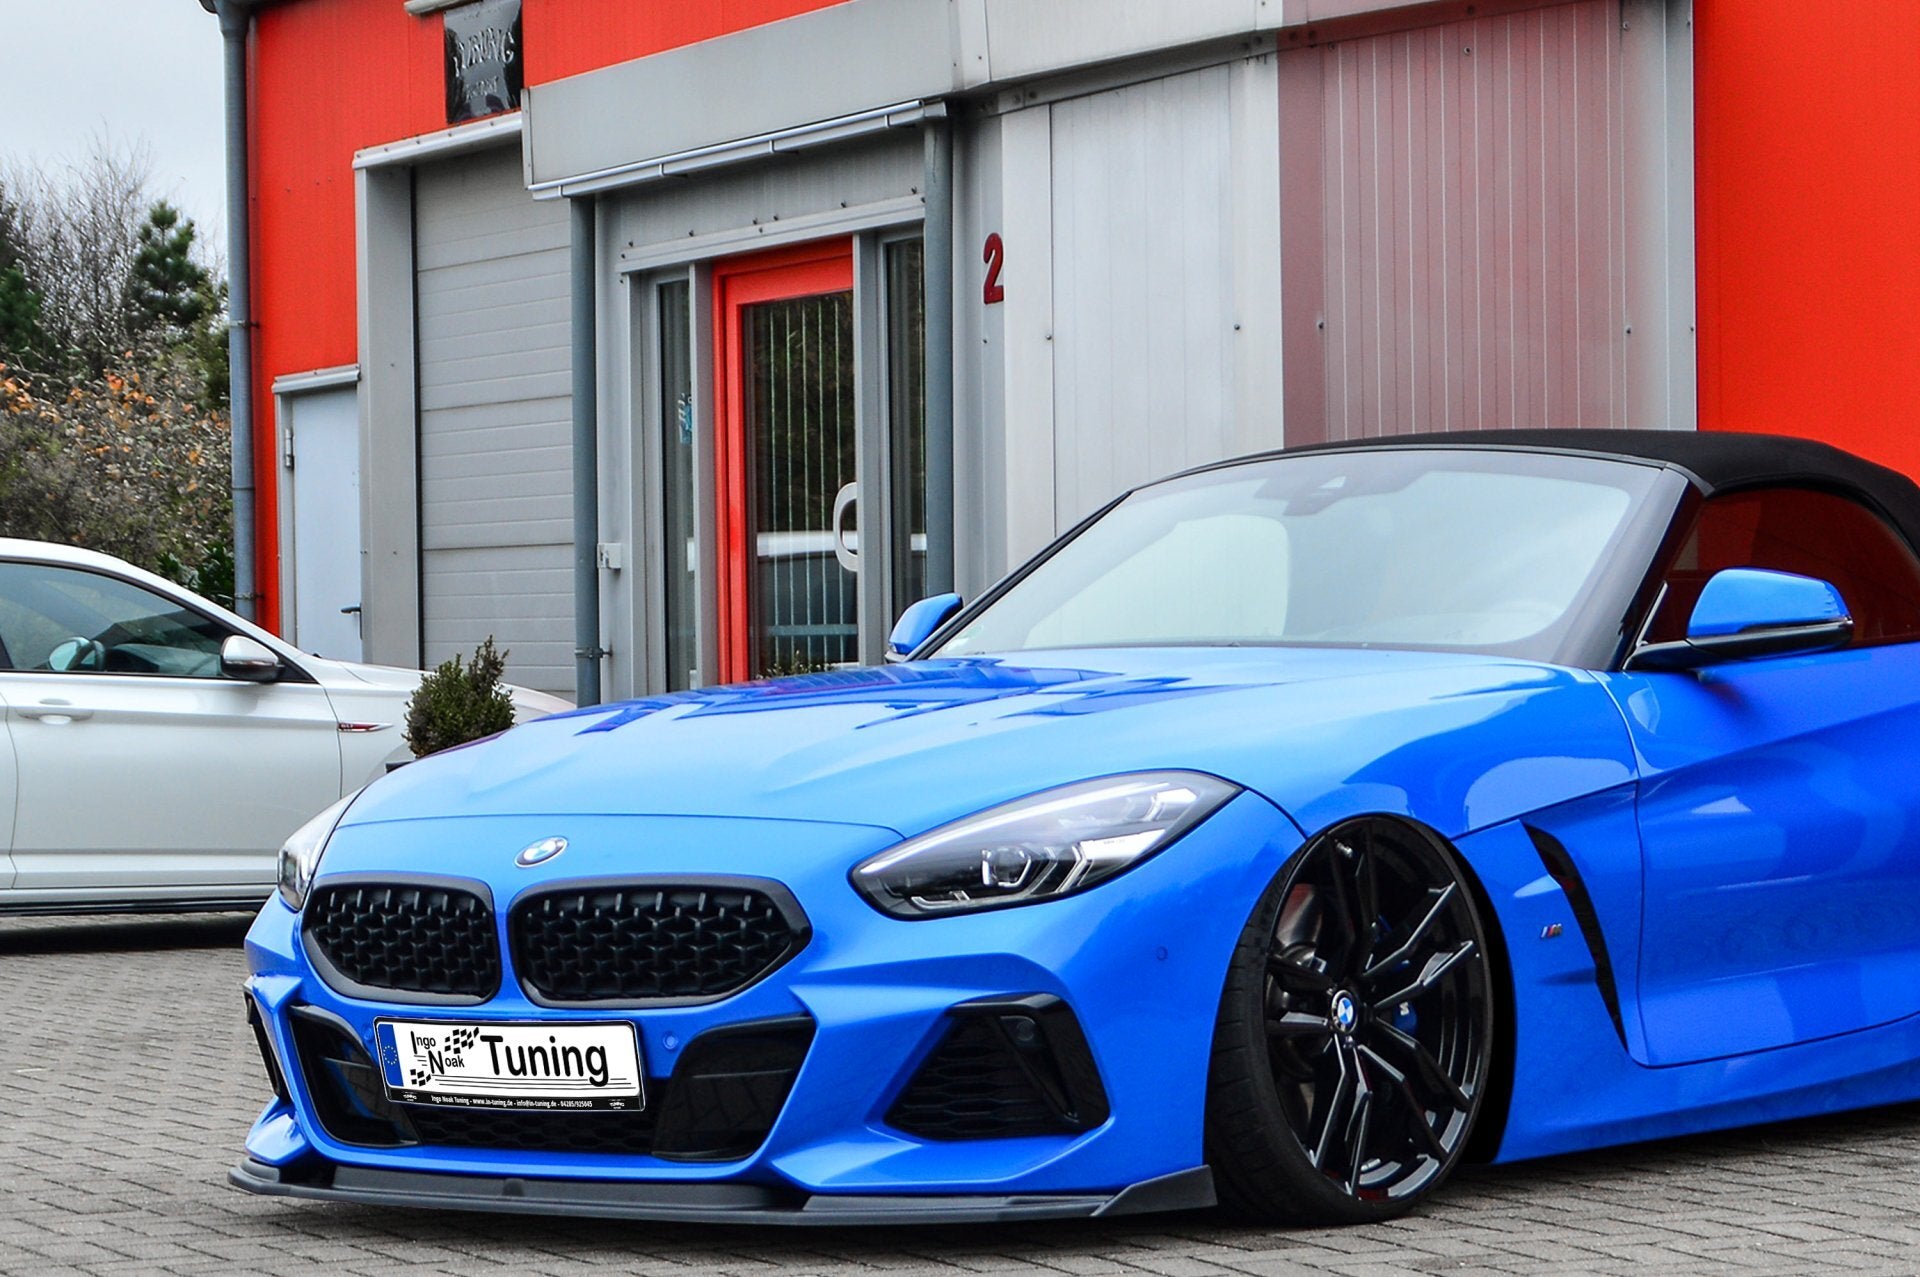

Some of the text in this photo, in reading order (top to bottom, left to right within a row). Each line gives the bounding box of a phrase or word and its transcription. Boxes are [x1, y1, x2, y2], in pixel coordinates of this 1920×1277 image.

[983, 232, 1004, 305] 2
[410, 1030, 436, 1055] Ingo
[428, 1050, 465, 1075] Noak
[480, 1035, 608, 1087] Tuning
[454, 1097, 470, 1105] Tuning
